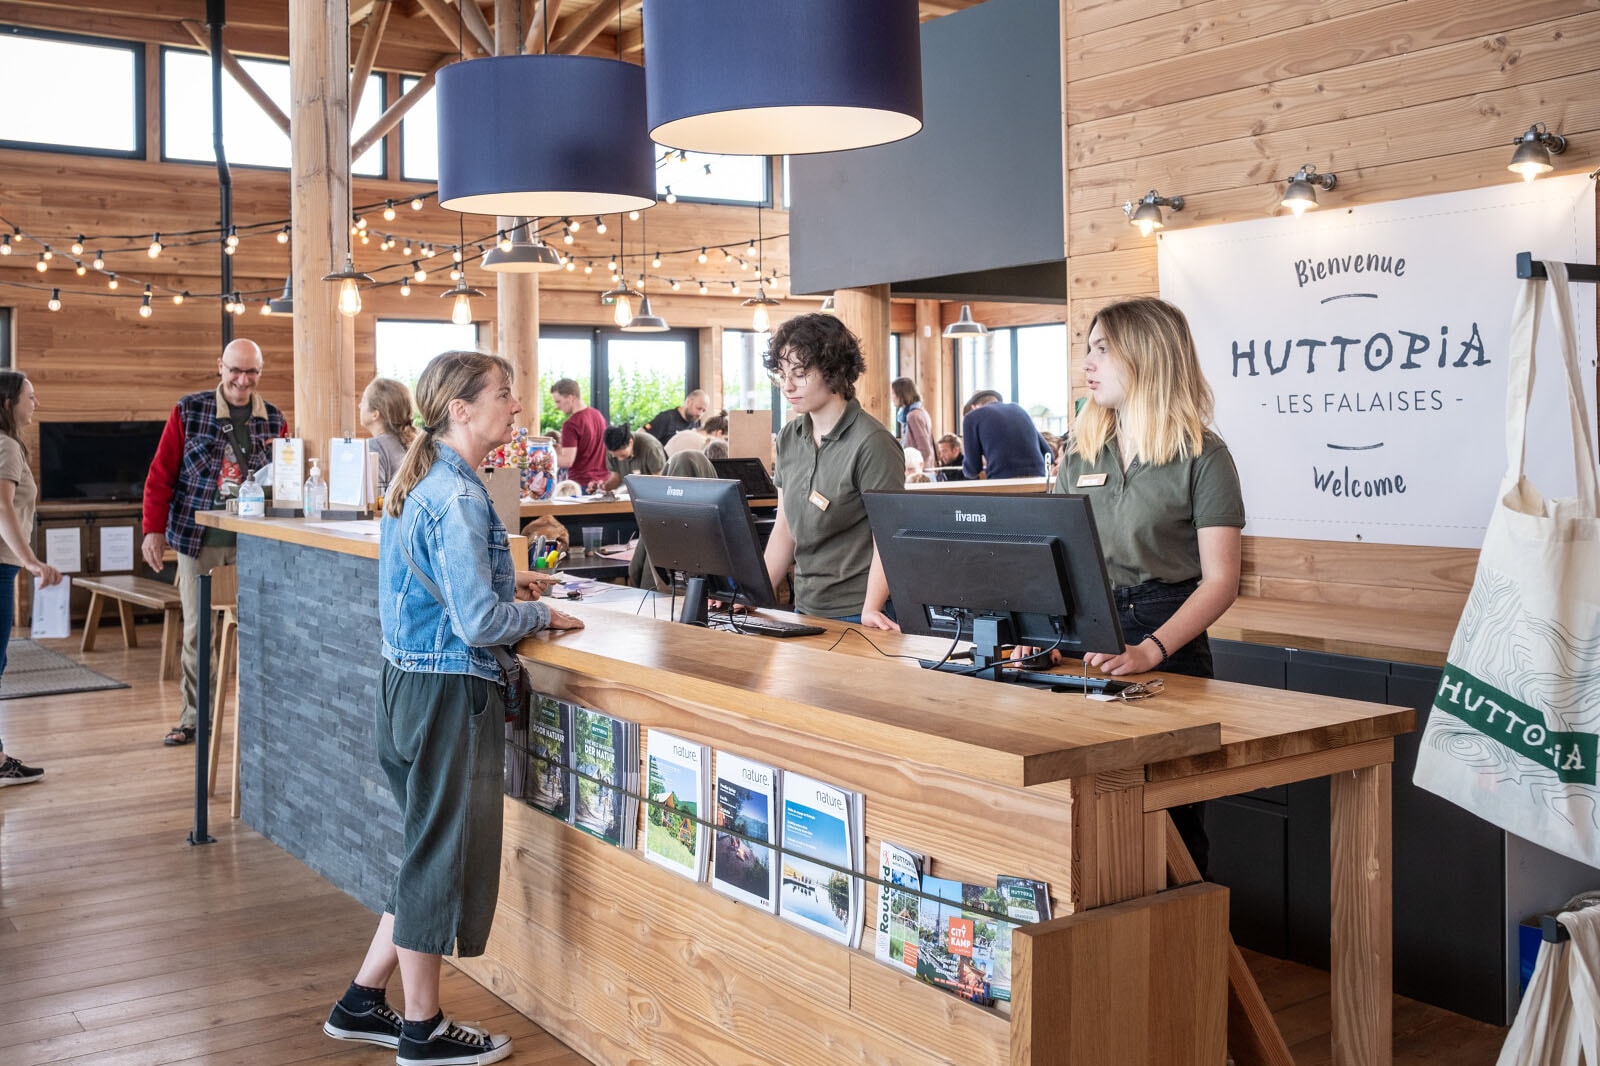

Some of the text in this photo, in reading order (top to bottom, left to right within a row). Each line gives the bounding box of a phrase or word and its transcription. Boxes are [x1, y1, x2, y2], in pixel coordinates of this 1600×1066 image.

[1294, 253, 1406, 287] Bienvenue
[1276, 390, 1443, 414] LES FALAISES
[1313, 465, 1407, 498] Welcome
[955, 509, 987, 522] iiyama
[1438, 675, 1586, 770] HUTTOiA
[584, 744, 596, 757] DER
[595, 748, 615, 763] NATUR
[950, 936, 971, 948] KAMP
